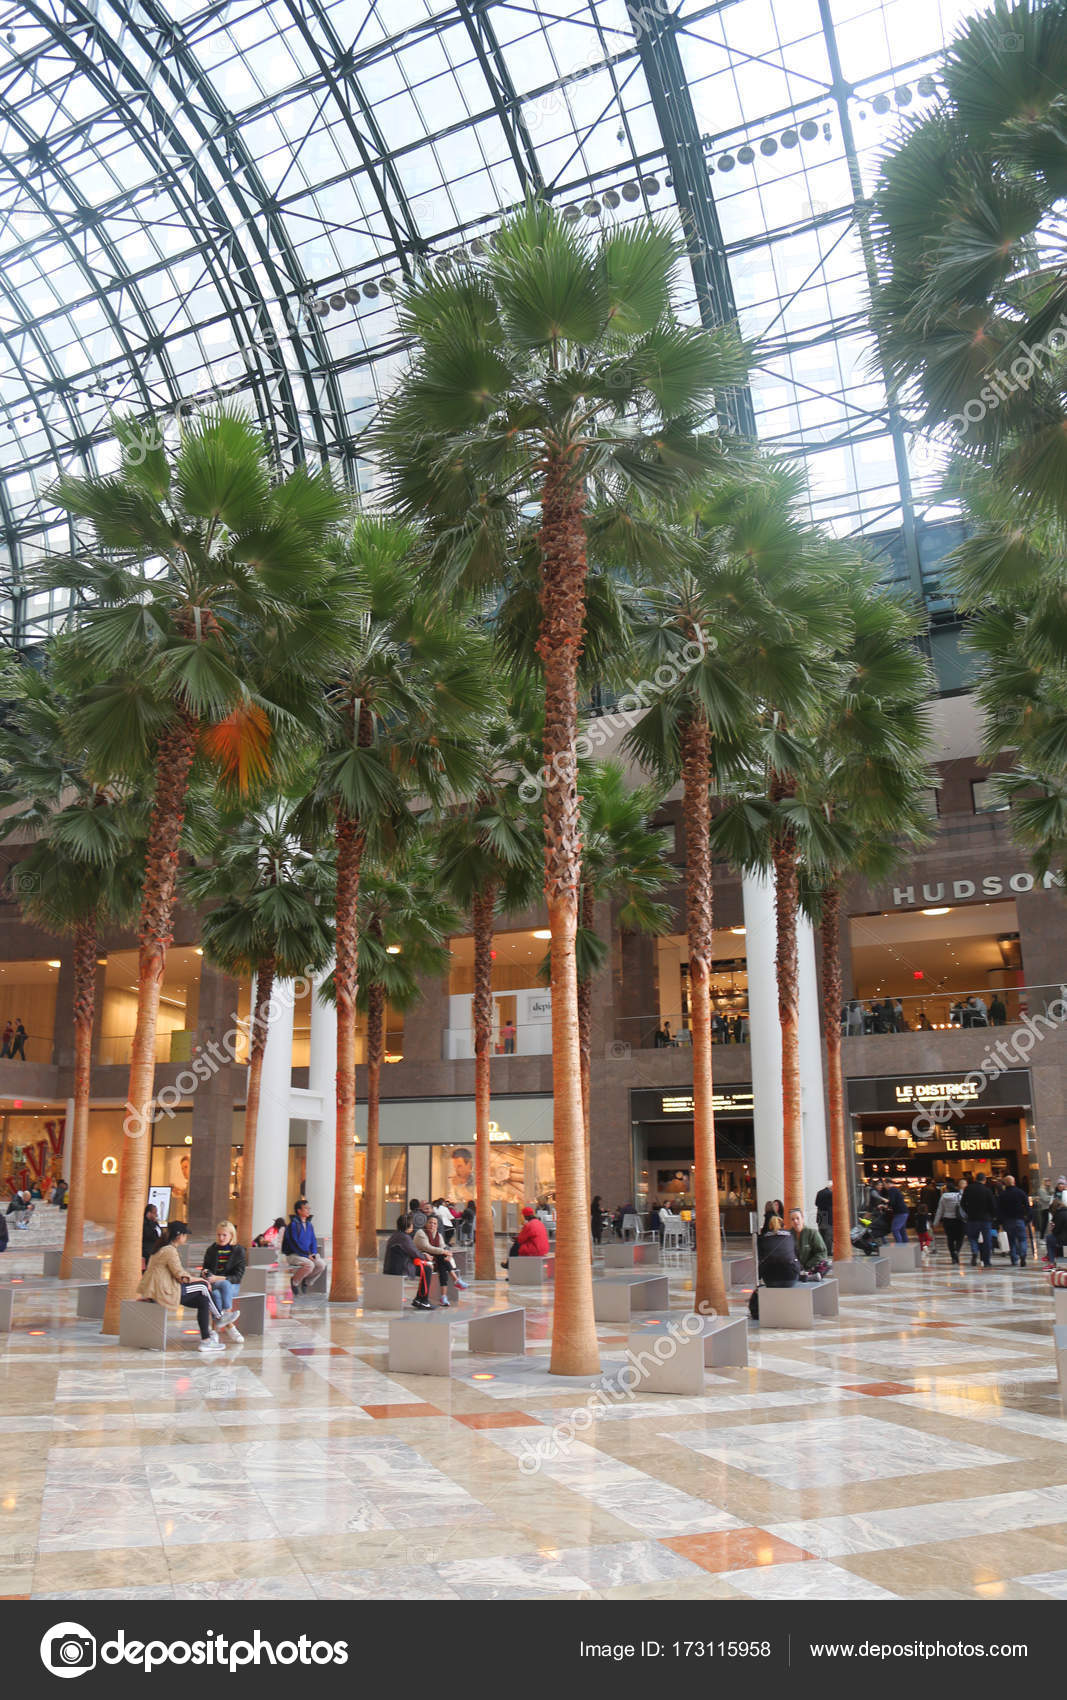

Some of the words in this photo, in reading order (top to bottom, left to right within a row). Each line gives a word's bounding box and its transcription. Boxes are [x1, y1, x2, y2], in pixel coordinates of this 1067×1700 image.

[893, 869, 1066, 905] HUDSON
[896, 1086, 913, 1097] LE
[915, 1083, 978, 1096] DISTRICT
[946, 1140, 959, 1151] LE
[960, 1138, 1001, 1150] DISTRICT
